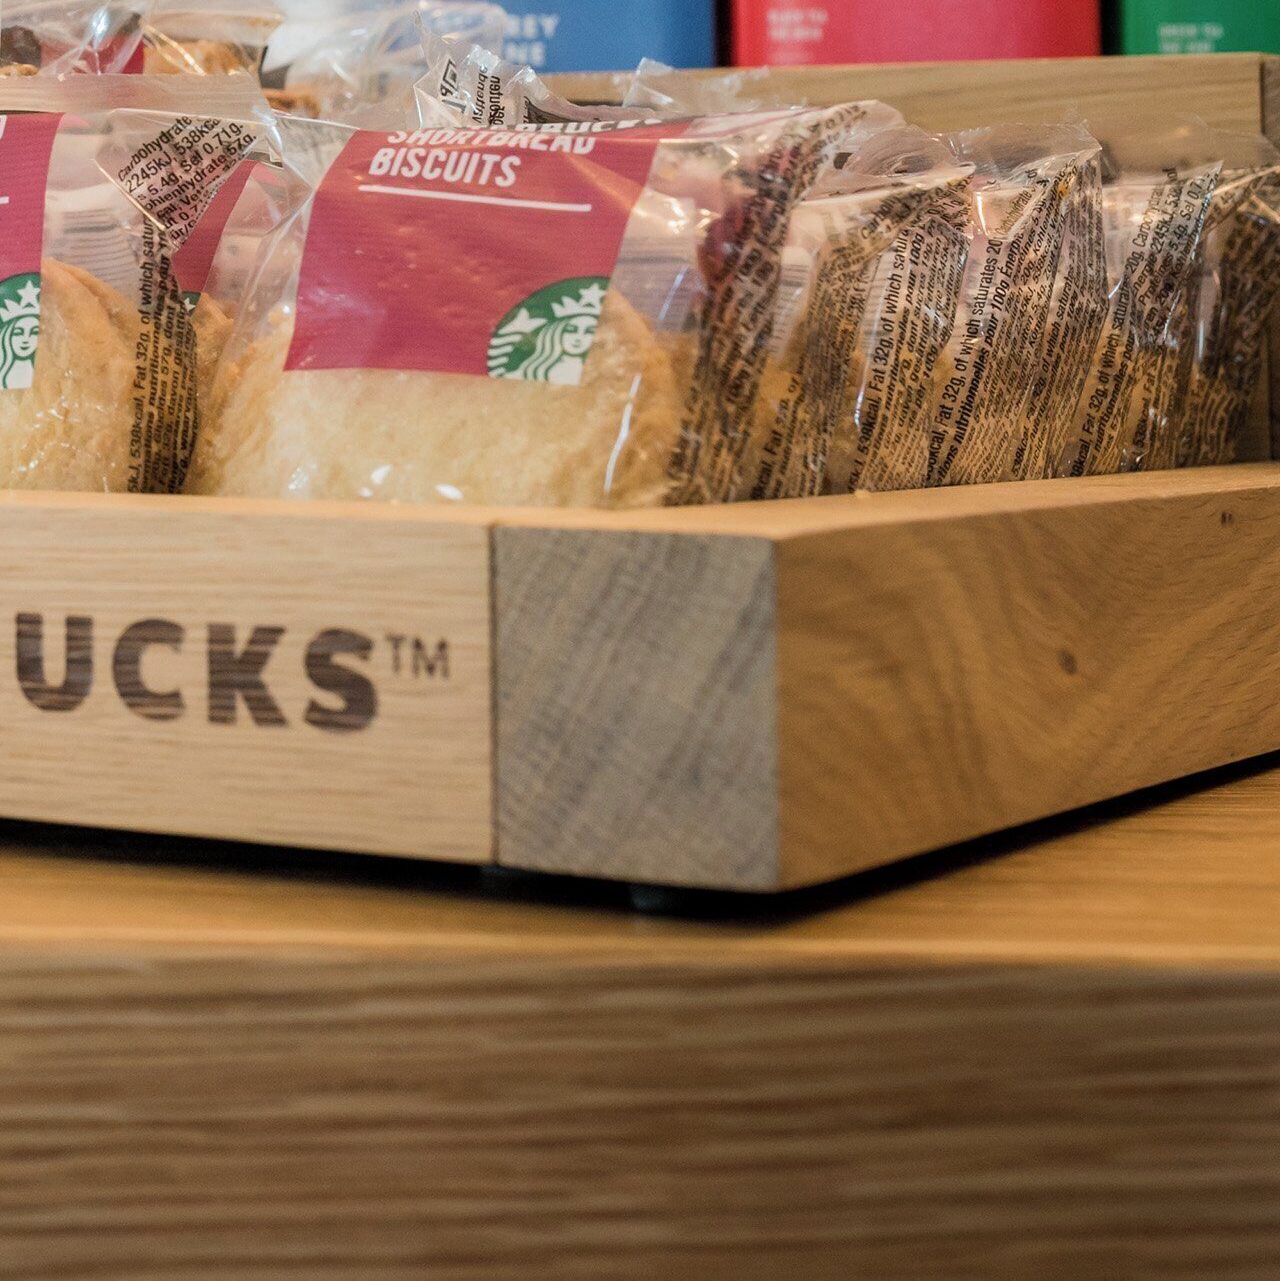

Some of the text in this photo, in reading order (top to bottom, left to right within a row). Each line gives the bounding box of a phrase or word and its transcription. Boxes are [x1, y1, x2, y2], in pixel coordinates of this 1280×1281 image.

[123, 148, 176, 194] 2245kJ,
[147, 167, 181, 198] 5.4g,
[369, 147, 523, 188] BISCUITS
[1179, 200, 1195, 220] Sel
[137, 262, 154, 304] which
[904, 269, 921, 304] pour
[138, 309, 150, 323] of
[934, 256, 999, 426] Fat 32g, of which saturates
[1042, 321, 1060, 357] which
[1081, 248, 1144, 434] Fat 32g, of which 20g,
[133, 365, 146, 388] Fat
[855, 272, 904, 454] 538kcal, Fat 32g, of which
[950, 280, 1010, 443] nutritionnelles pour 100g
[1039, 359, 1050, 372] of
